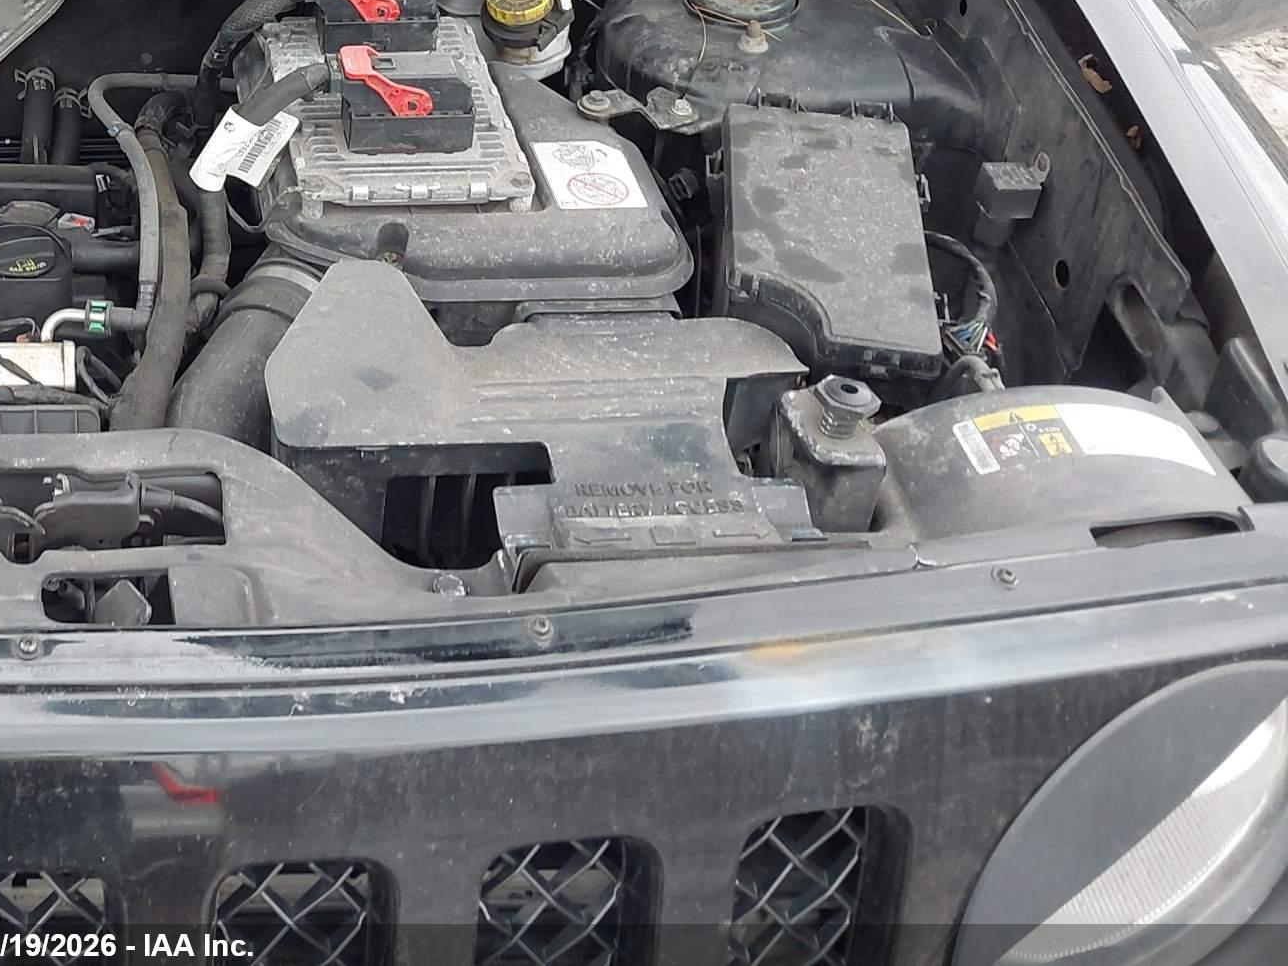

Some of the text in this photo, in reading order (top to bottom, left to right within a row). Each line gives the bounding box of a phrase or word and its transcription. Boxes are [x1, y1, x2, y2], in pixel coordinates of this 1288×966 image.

[574, 479, 713, 497] REMOVE FOR
[564, 498, 744, 518] BATTERY ACCESS
